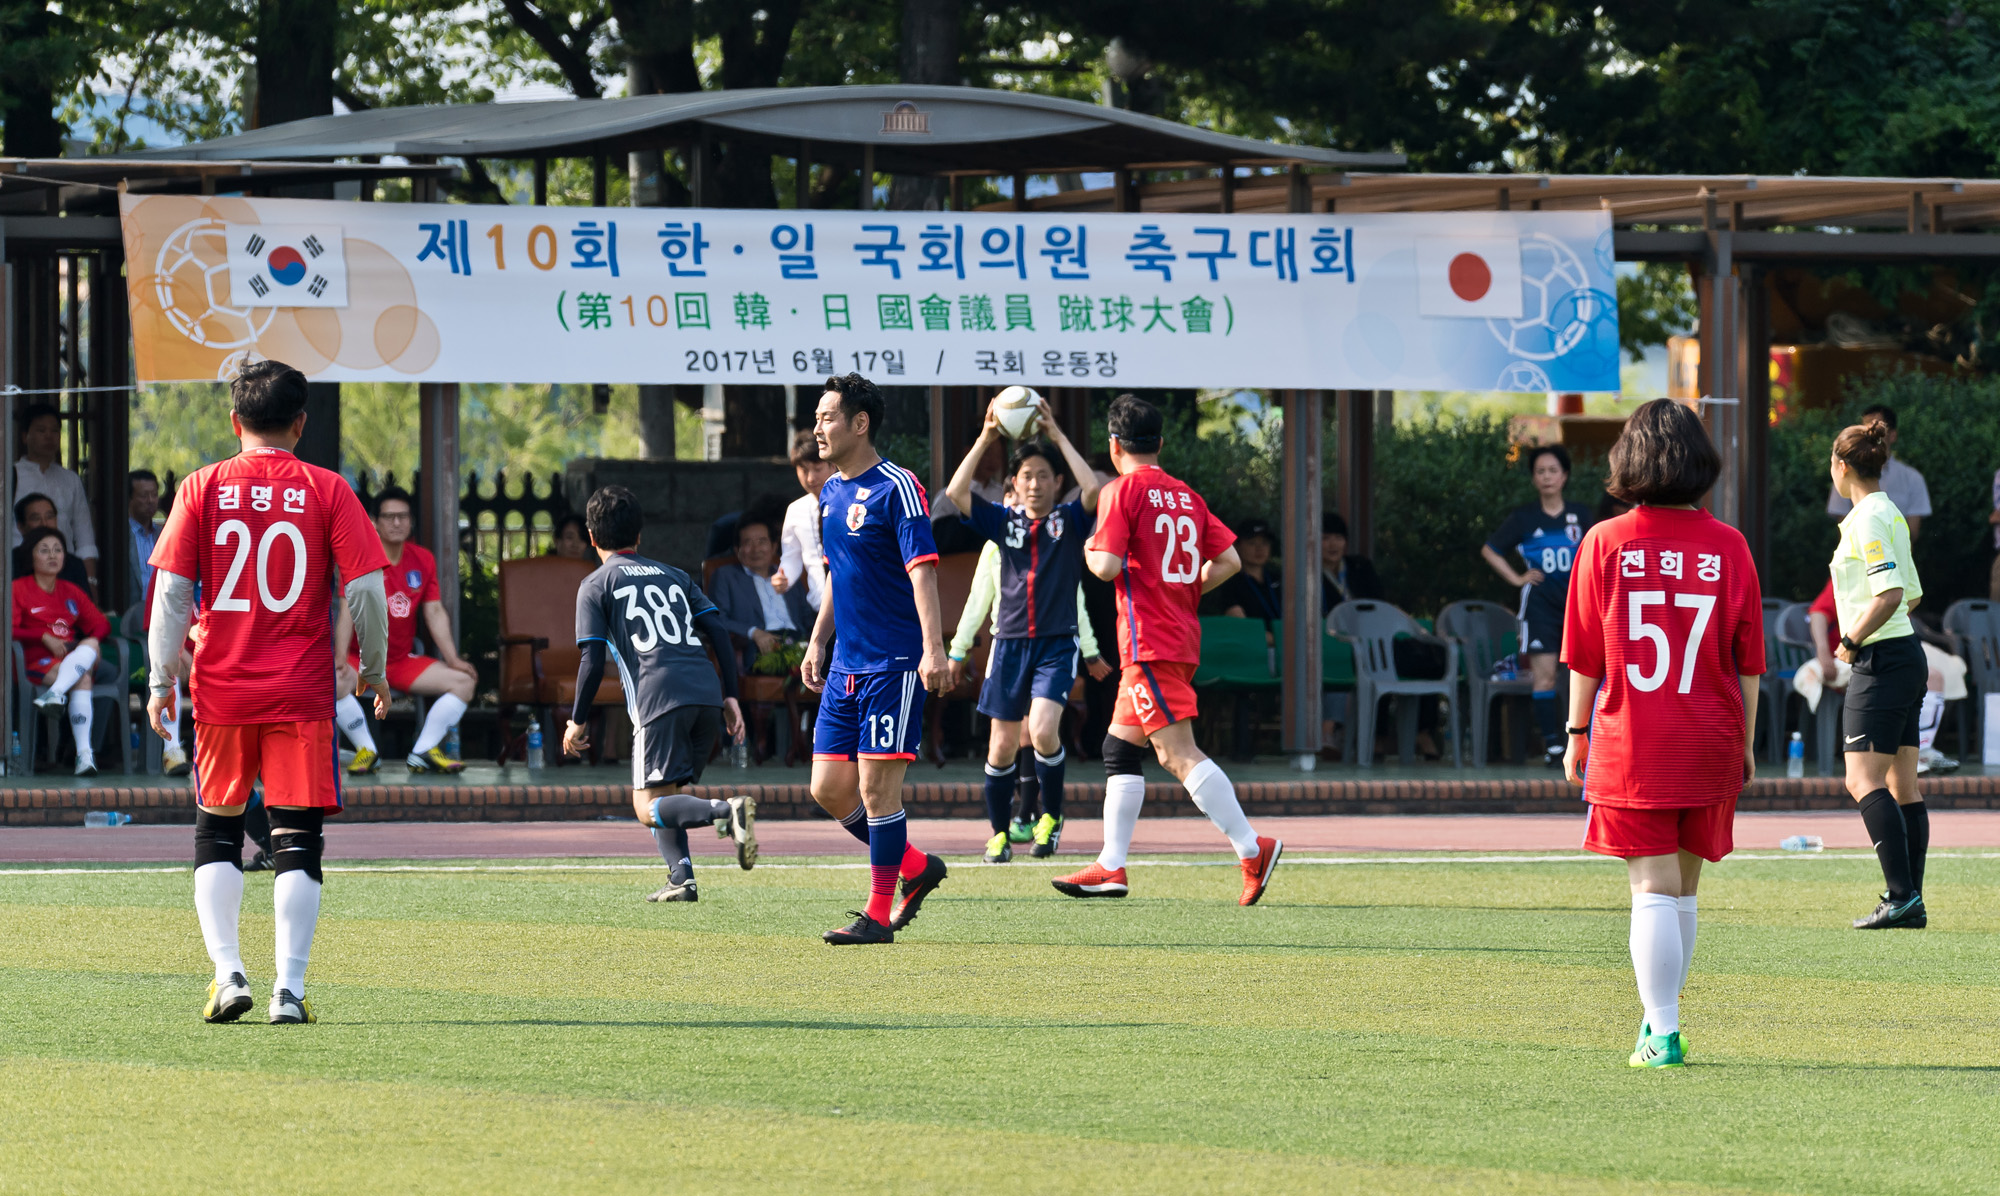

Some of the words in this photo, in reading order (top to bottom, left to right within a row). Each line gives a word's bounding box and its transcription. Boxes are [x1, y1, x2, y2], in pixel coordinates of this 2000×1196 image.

[417, 219, 620, 277] 제10회
[853, 224, 1091, 281] 국회의원
[1125, 225, 1357, 284] 축구대회
[877, 292, 1036, 333] 國會議員
[685, 348, 776, 374] 2017년
[792, 348, 835, 375] 6월
[851, 349, 905, 375] 17일
[936, 349, 945, 375] /
[974, 350, 1025, 376] 국회
[1041, 350, 1119, 378] 운동장
[217, 485, 307, 514] 김명연
[1147, 488, 1194, 510] 위성곤
[211, 518, 308, 613] 20
[1154, 513, 1200, 584] 23
[1541, 547, 1572, 574] 80
[1619, 549, 1722, 582] 전희경
[618, 565, 666, 577] TAKUMA
[612, 583, 703, 652] 382
[1626, 590, 1718, 694] 57
[1127, 683, 1154, 716] 23
[868, 714, 895, 749] 13
